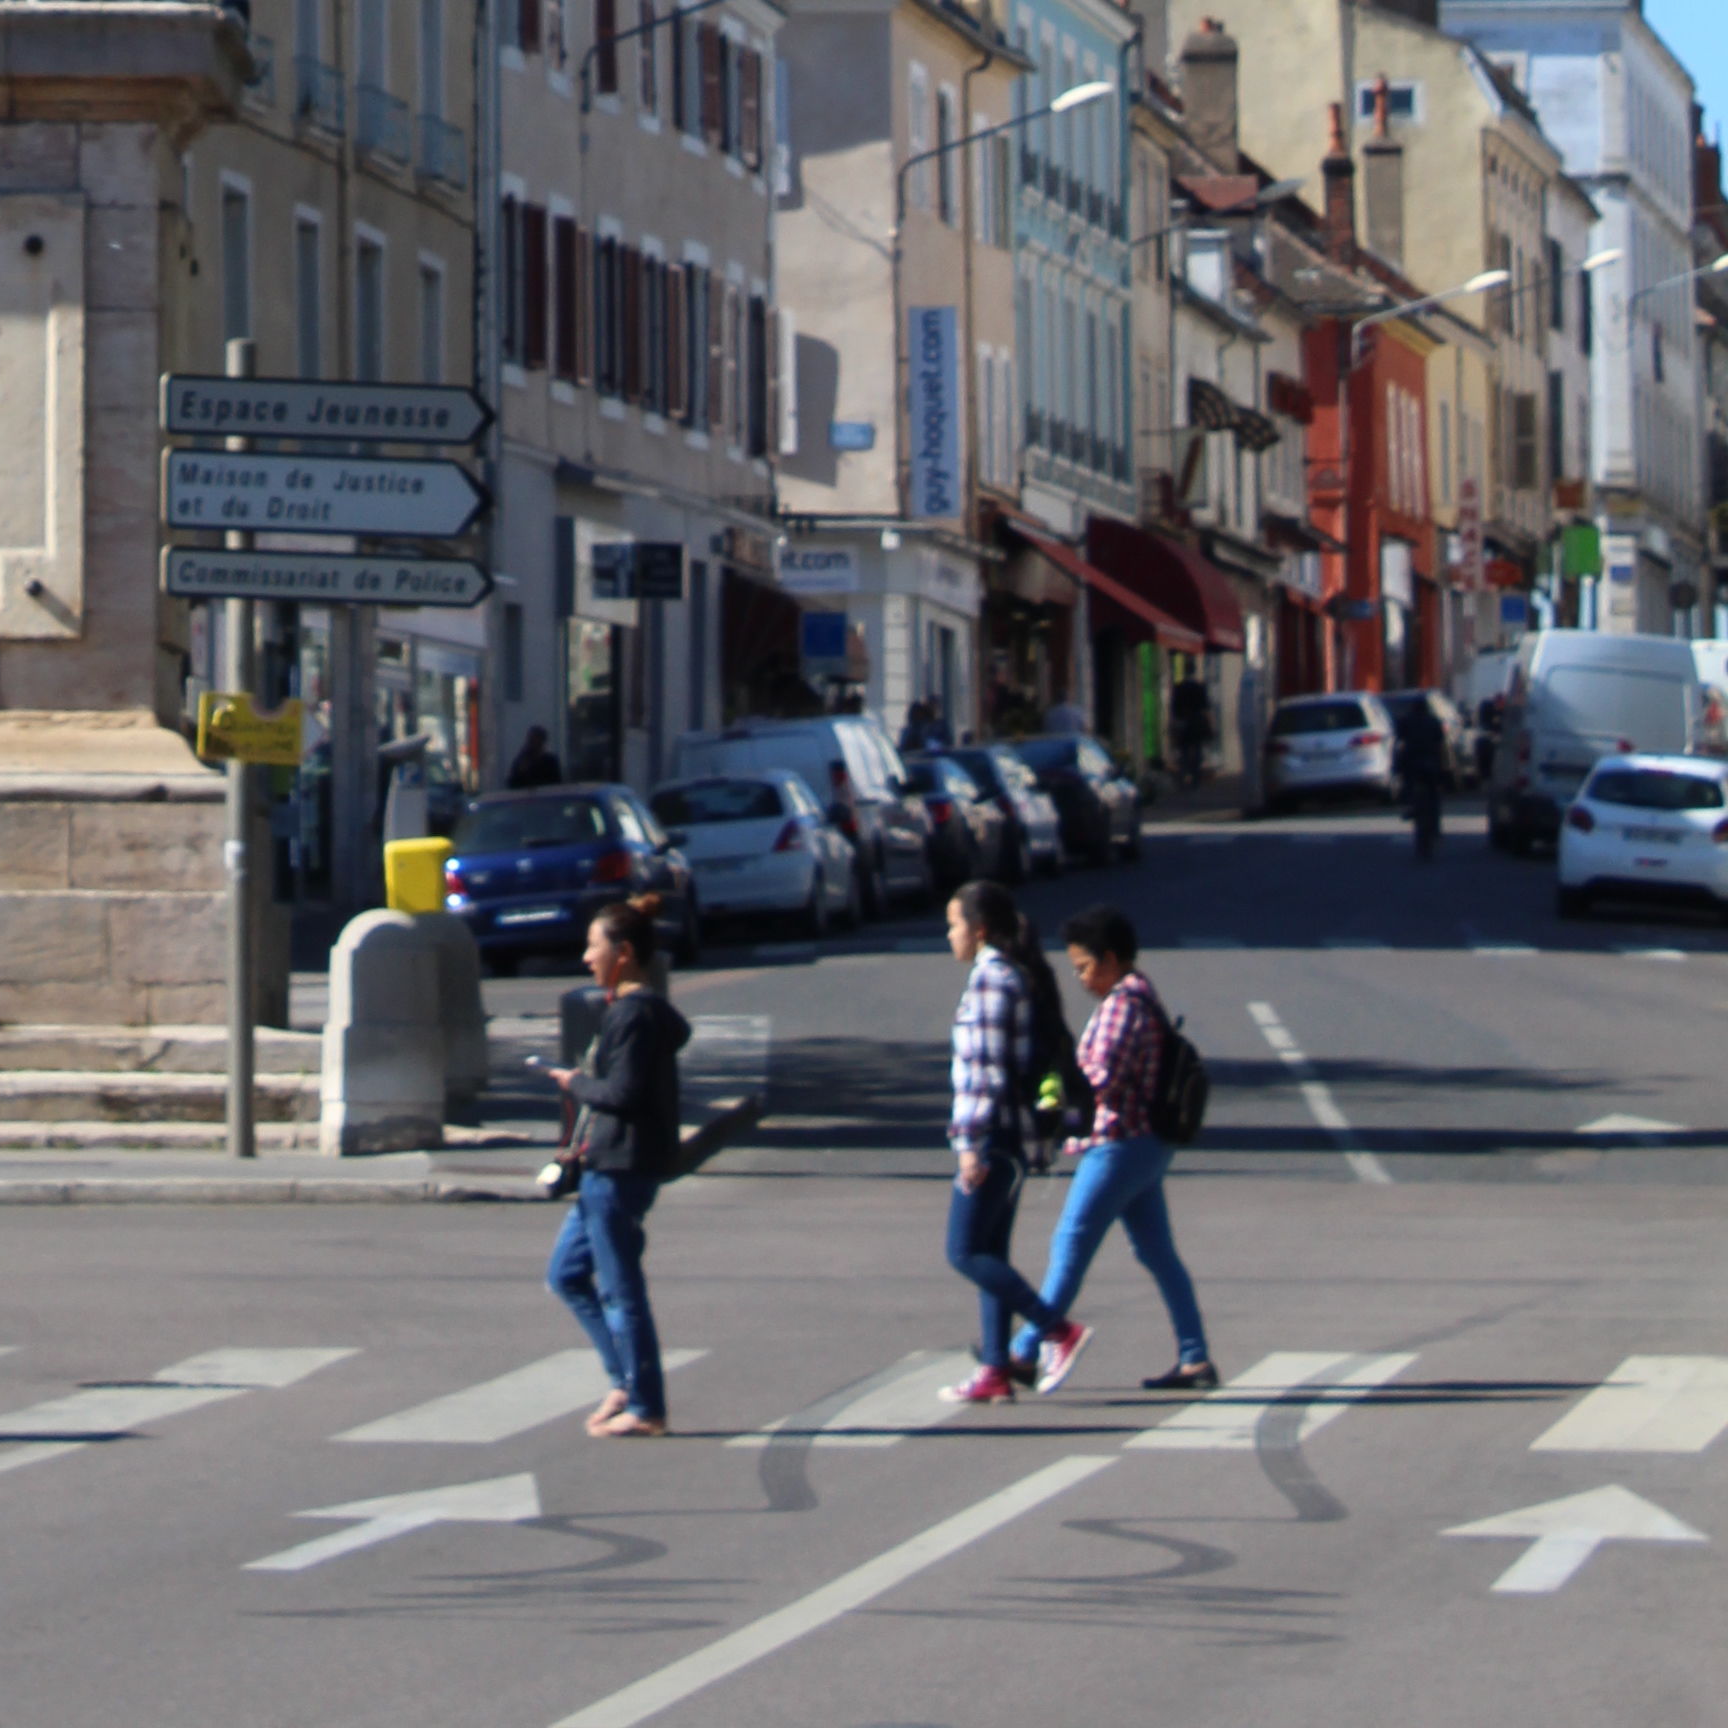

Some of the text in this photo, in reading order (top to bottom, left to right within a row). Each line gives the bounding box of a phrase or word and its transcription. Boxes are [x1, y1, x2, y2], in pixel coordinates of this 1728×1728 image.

[179, 391, 451, 429] Espace Jeunesse
[919, 309, 952, 514] guy-hoquet.com
[177, 462, 426, 495] Maison de Justice
[177, 496, 332, 522] et du Droit
[179, 560, 468, 595] Commissariat de Police
